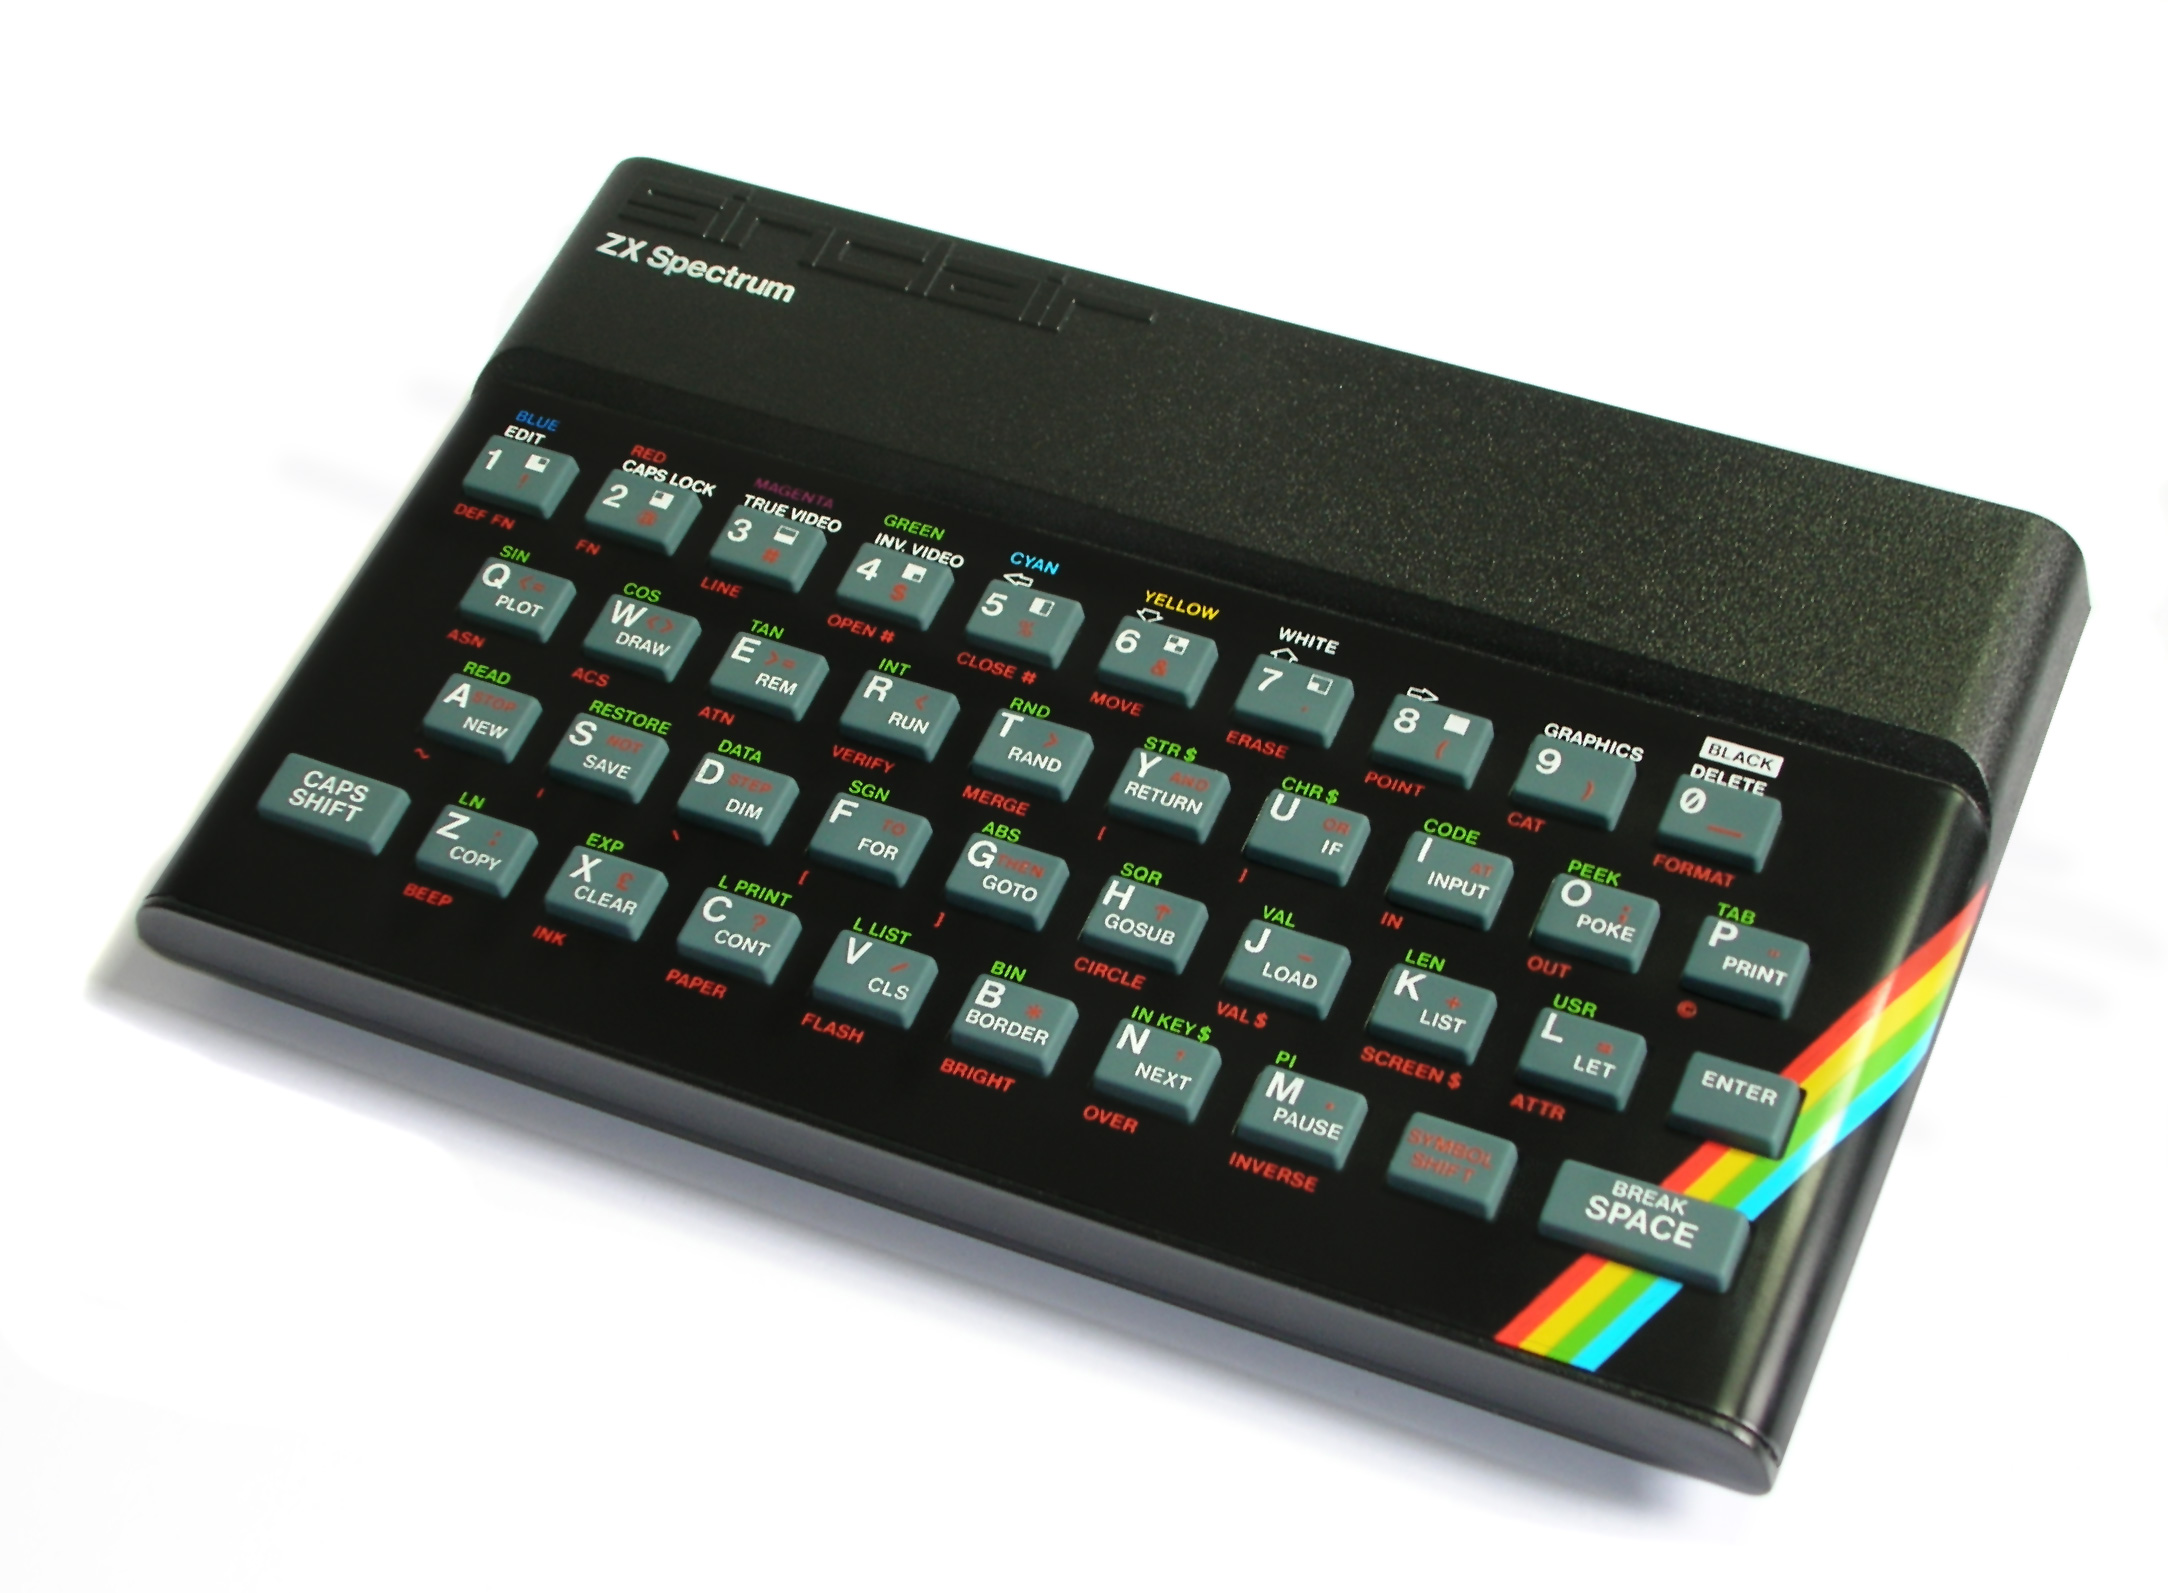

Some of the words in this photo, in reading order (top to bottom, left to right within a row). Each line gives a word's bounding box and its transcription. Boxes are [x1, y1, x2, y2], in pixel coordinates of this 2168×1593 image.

[596, 232, 648, 263] ZX
[646, 245, 796, 303] Spectrum
[515, 410, 558, 432] BLUE
[504, 425, 546, 445] EDIT
[485, 449, 503, 471] 1
[630, 444, 667, 464] RED
[622, 459, 669, 483] CAPS
[669, 473, 717, 497] LOCK
[602, 484, 629, 509] 2
[754, 477, 833, 509] MAGENTA
[453, 503, 488, 521] DEF
[490, 513, 515, 531] FN
[744, 494, 789, 518] TRUE
[791, 507, 842, 533] VIDEO
[727, 518, 753, 543] 3
[883, 515, 945, 542] GREEN
[501, 545, 530, 564] SIN
[575, 539, 601, 556] FN
[874, 532, 907, 551] INV.
[912, 543, 965, 568] VIDEO
[482, 563, 511, 590] Q
[856, 558, 882, 581] 4
[1009, 551, 1060, 576] CYAN
[623, 583, 661, 603] COS
[700, 577, 742, 599] LINE
[495, 594, 544, 617] PLOT
[611, 599, 649, 628] W
[981, 592, 1008, 617] 5
[1145, 590, 1220, 621] YELLOW
[446, 629, 486, 649] ASN
[751, 620, 784, 640] TAN
[826, 613, 878, 638] OPEN
[615, 631, 671, 657] DRAW
[730, 636, 762, 664] E
[1115, 628, 1141, 654] 6
[1279, 626, 1340, 655] WHITE
[463, 661, 512, 686] READ
[571, 667, 610, 688] ACS
[879, 658, 911, 676] INT
[956, 651, 1017, 680] CLOSE
[1257, 666, 1284, 692] 7
[442, 682, 471, 709] A
[755, 672, 798, 696] REM
[863, 674, 894, 703] R
[472, 692, 516, 711] STOP
[1009, 697, 1051, 720] RND
[1089, 690, 1144, 717] MOVE
[462, 716, 509, 739] NEW
[589, 700, 672, 736] RESTORE
[697, 706, 735, 726] ATN
[887, 711, 930, 735] RUN
[999, 711, 1025, 738] T
[1393, 707, 1421, 734] 8
[568, 720, 598, 747] S
[1143, 736, 1182, 758] STR
[1225, 729, 1289, 760] ERASE
[1544, 723, 1644, 762] GRAPHICS
[717, 739, 762, 764] DATA
[831, 745, 895, 774] VERIFY
[1007, 745, 1062, 773] RAND
[1137, 751, 1163, 779] Y
[1535, 747, 1562, 775] 9
[1708, 743, 1775, 772] BLACK
[582, 754, 632, 780] SAVE
[694, 758, 725, 785] D
[1689, 763, 1768, 797] DELETE
[304, 770, 370, 803] CAPS
[728, 773, 773, 793] STEP
[849, 780, 890, 803] SGN
[1169, 772, 1209, 792] AND
[1281, 777, 1324, 800] CHR
[1364, 770, 1426, 797] POINT
[288, 788, 363, 822] SHIFT
[458, 793, 486, 810] LN
[725, 798, 764, 820] DIM
[828, 798, 860, 824] F
[961, 784, 1031, 817] MERGE
[1124, 780, 1204, 815] RETURN
[1270, 792, 1301, 822] U
[435, 811, 471, 840] Z
[981, 821, 1022, 844] ABS
[1422, 818, 1479, 847] CODE
[1506, 811, 1546, 833] CAT
[586, 833, 625, 853] EXP
[857, 837, 899, 861] FOR
[967, 839, 998, 870] G
[1321, 839, 1344, 856] IF
[1417, 836, 1434, 863] I
[449, 845, 502, 871] COPY
[569, 853, 603, 883] X
[998, 855, 1045, 878] THEN
[1652, 853, 1735, 888] FORMAT
[1120, 862, 1163, 886] SQR
[1427, 870, 1491, 900] INPUT
[1567, 859, 1621, 887] PEEK
[402, 882, 454, 907] BEEP
[574, 885, 638, 916] CLEAR
[718, 876, 728, 891] L
[734, 879, 793, 906] PRINT
[982, 874, 1038, 902] GOTO
[1102, 879, 1136, 911] H
[1560, 878, 1593, 908] O
[702, 895, 733, 923] C
[1263, 906, 1295, 929] VAL
[1380, 911, 1404, 930] IN
[1717, 902, 1755, 927] TAB
[531, 925, 567, 947] INK
[852, 918, 863, 933] L
[868, 923, 912, 945] LIST
[1104, 913, 1176, 946] GOSUB
[1244, 927, 1272, 954] J
[1576, 913, 1636, 943] POKE
[1708, 920, 1739, 947] P
[714, 929, 771, 957] CONT
[846, 936, 873, 965] V
[990, 960, 1027, 983] BIN
[1073, 956, 1147, 991] CIRCLE
[1404, 950, 1446, 973] LEN
[1526, 955, 1572, 978] OUT
[1722, 955, 1788, 987] PRINT
[665, 968, 728, 1000] PAPER
[867, 977, 910, 1001] CLS
[1262, 961, 1318, 990] LOAD
[1393, 969, 1427, 1002] K
[974, 979, 1006, 1009] B
[1552, 994, 1598, 1019] USR
[1130, 1006, 1154, 1024] IN
[1156, 1014, 1196, 1035] KEY
[1216, 1001, 1249, 1025] VAL
[1419, 1008, 1467, 1034] LIST
[800, 1012, 865, 1044] FLASH
[965, 1008, 1050, 1046] BORDER
[1115, 1023, 1151, 1055] N
[1540, 1012, 1564, 1044] L
[1275, 1050, 1297, 1069] PI
[1359, 1045, 1445, 1084] SCREEN
[1573, 1054, 1617, 1079] LET
[939, 1057, 1016, 1093] BRIGHT
[1134, 1061, 1193, 1091] NEXT
[1265, 1070, 1305, 1106] M
[1701, 1070, 1778, 1107] ENTER
[1082, 1104, 1139, 1135] OVER
[1509, 1093, 1566, 1121] ATTR
[1272, 1106, 1344, 1141] PAUSE
[1408, 1128, 1494, 1171] SYMBOL
[1228, 1151, 1319, 1193] INVERSE
[1410, 1152, 1476, 1185] SHIFT
[1611, 1179, 1688, 1217] BREAK
[1584, 1193, 1700, 1250] SPACE
